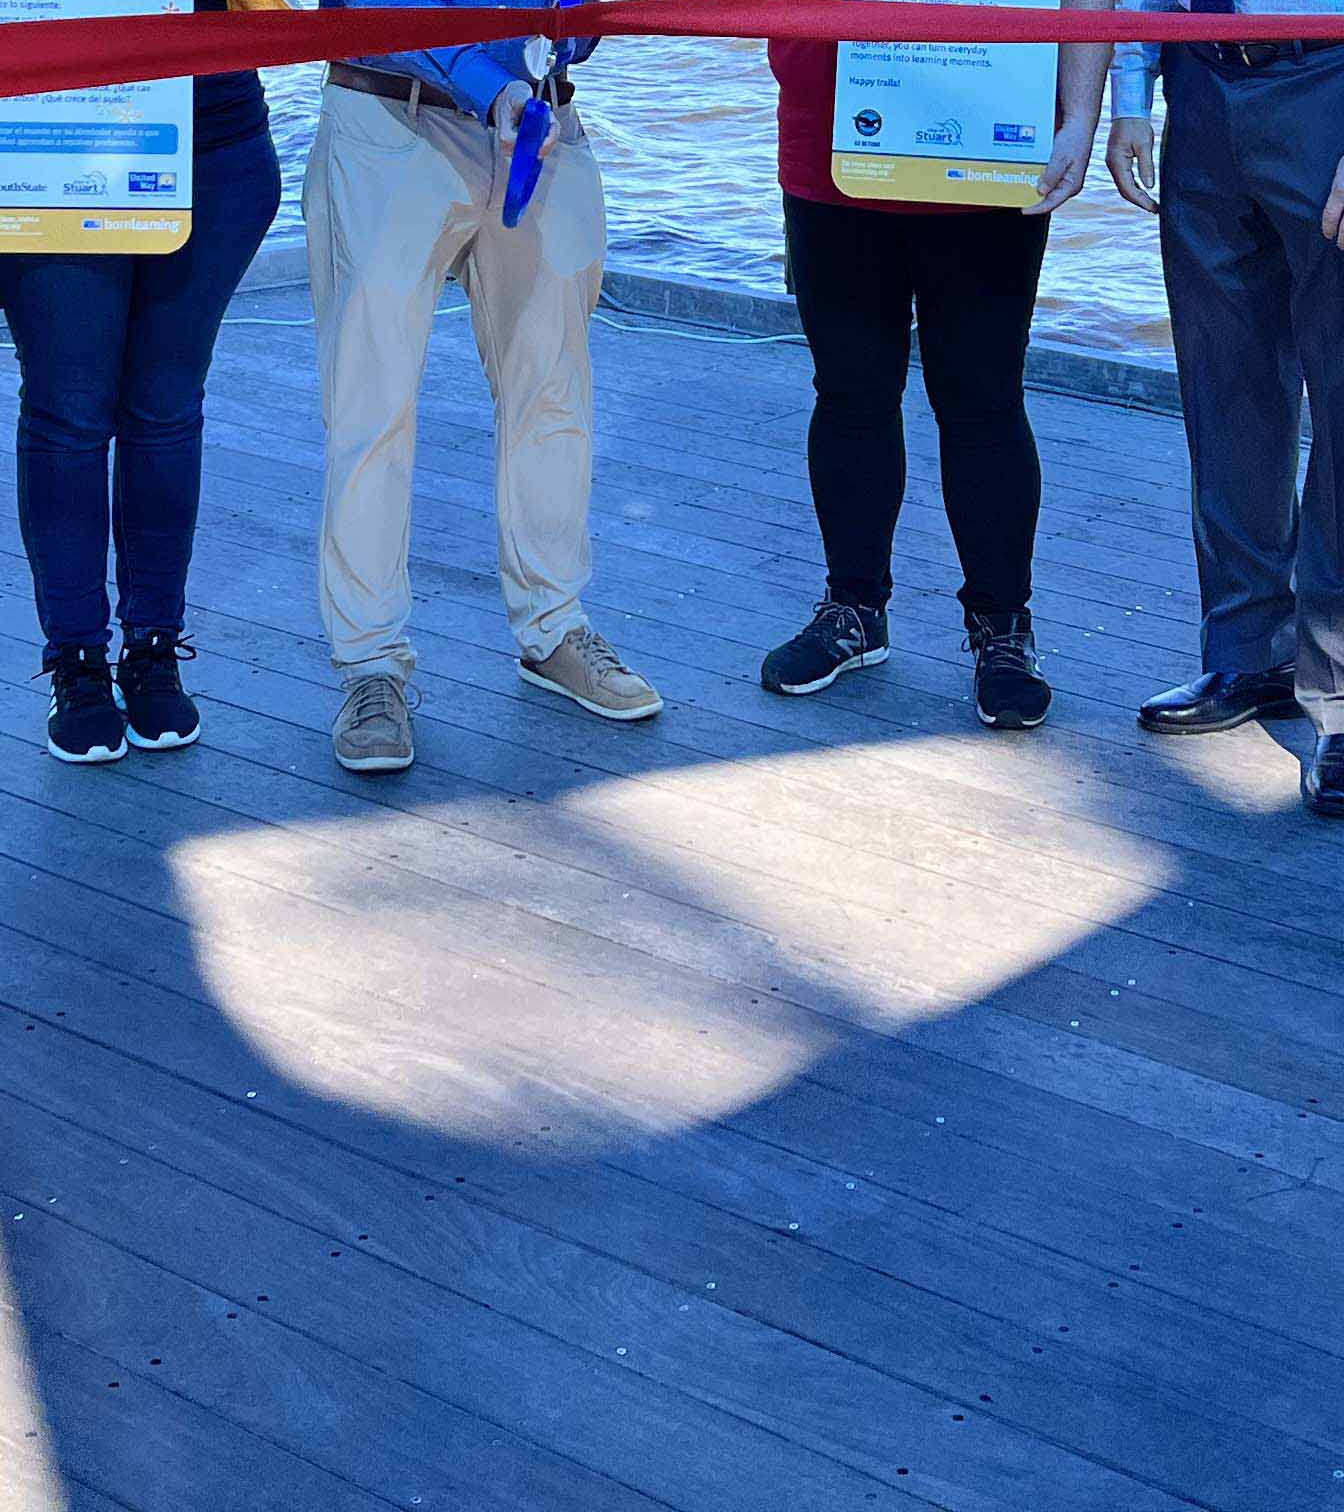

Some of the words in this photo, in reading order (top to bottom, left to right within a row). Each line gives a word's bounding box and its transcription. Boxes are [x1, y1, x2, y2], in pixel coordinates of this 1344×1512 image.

[893, 42, 909, 51] you
[911, 43, 927, 51] can
[928, 43, 946, 52] turn
[948, 45, 988, 57] everyday
[850, 51, 892, 62] moments
[893, 53, 910, 63] into
[911, 55, 948, 67] learning
[949, 57, 993, 68] moments.
[849, 75, 876, 87] Happy
[916, 130, 953, 143] Stuart
[64, 183, 98, 193] Stuart
[106, 217, 181, 233] bornlearning
